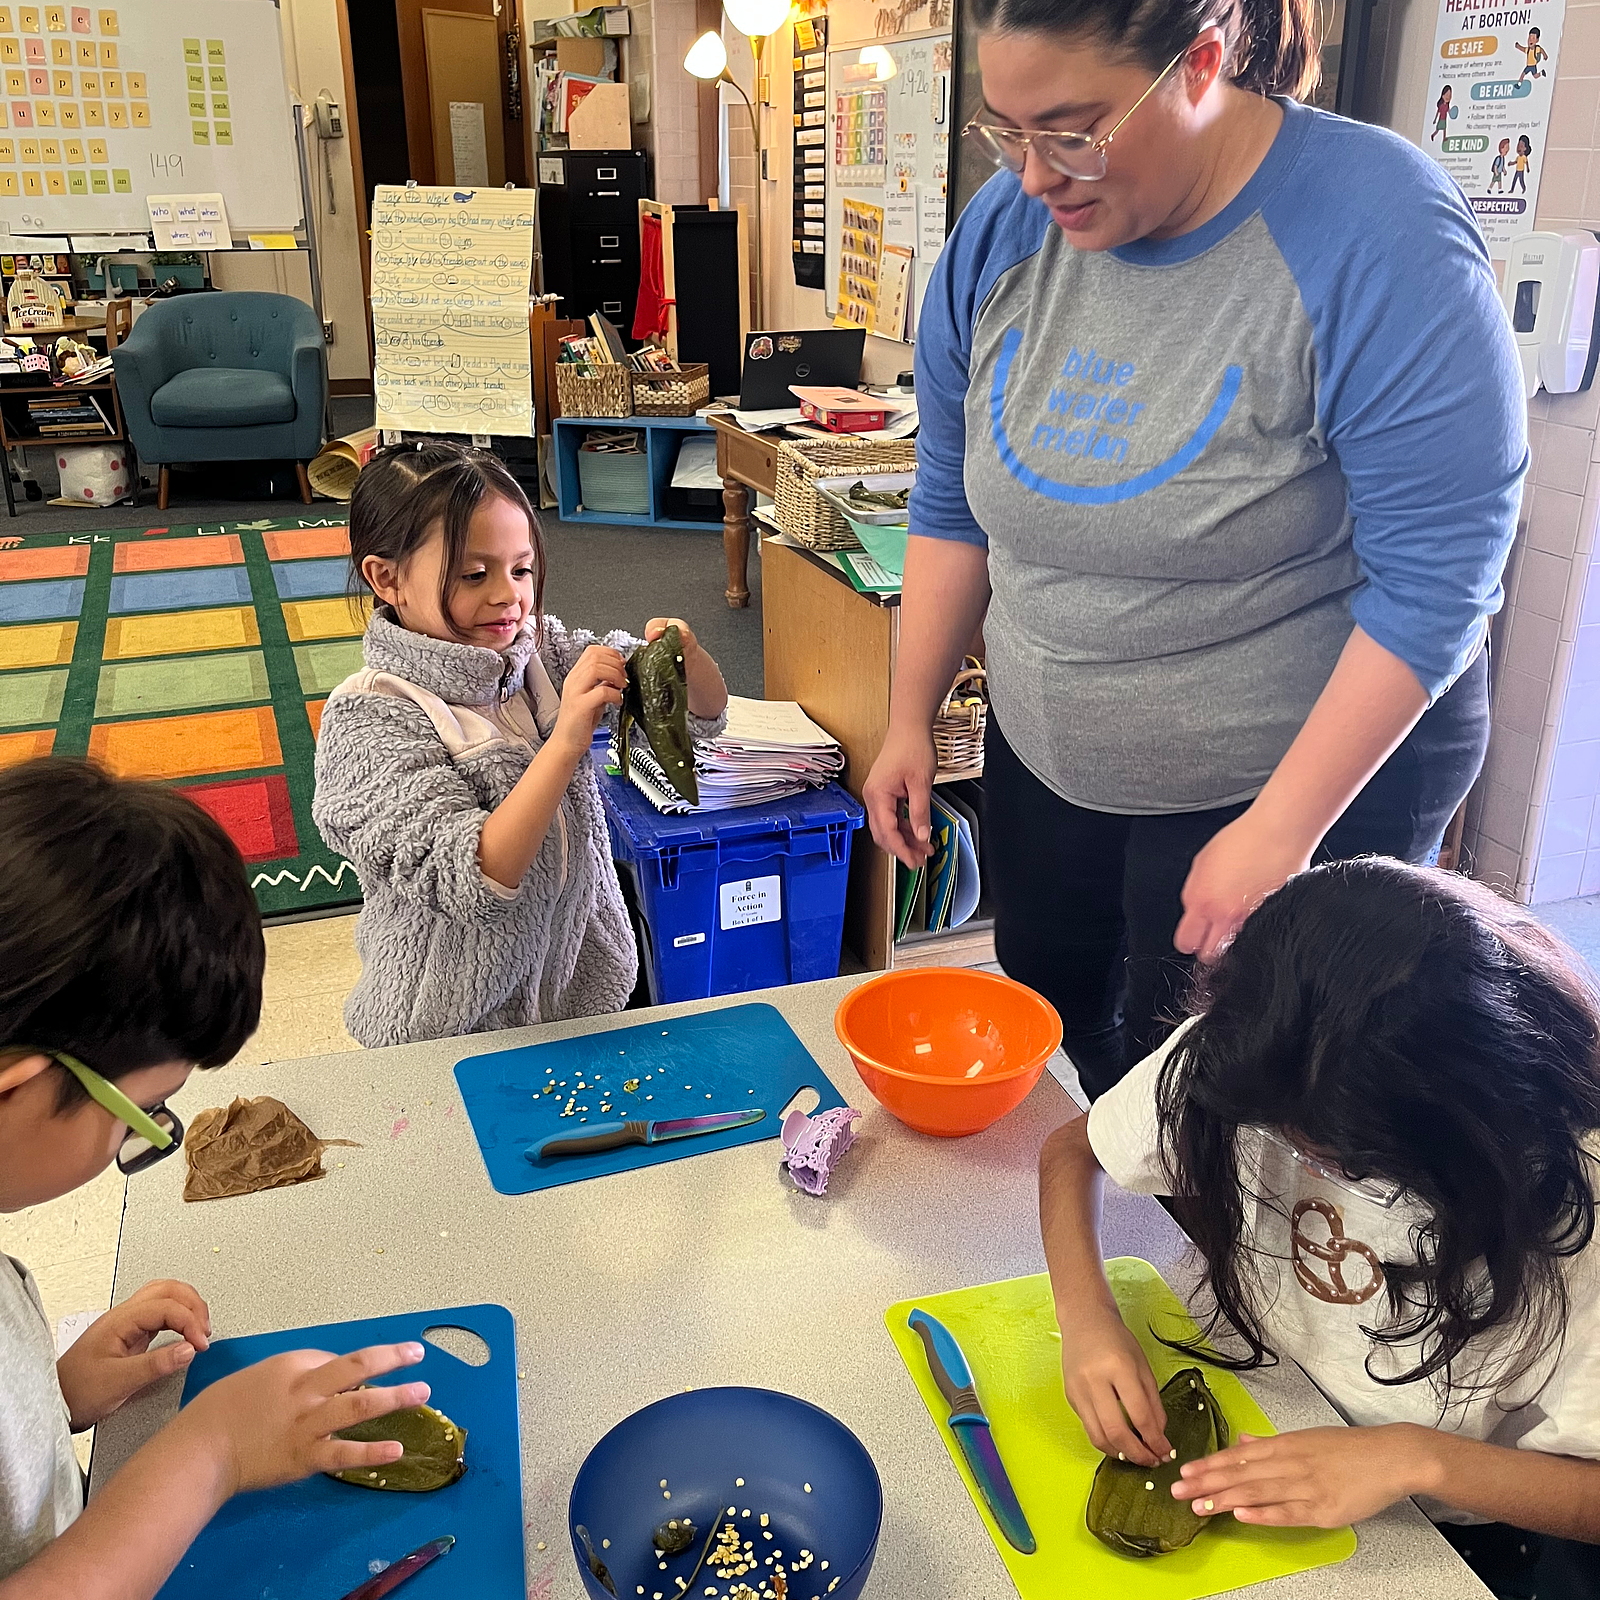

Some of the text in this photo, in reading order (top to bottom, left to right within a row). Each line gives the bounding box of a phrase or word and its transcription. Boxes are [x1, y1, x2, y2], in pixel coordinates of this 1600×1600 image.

[52, 13, 58, 22] d
[106, 17, 111, 25] f
[1462, 9, 1531, 30] AT BORTON!
[6, 45, 13, 53] h
[59, 48, 63, 57] j
[83, 48, 89, 57] k
[1448, 41, 1484, 55] BE SAFE
[59, 79, 66, 88] p
[85, 81, 95, 89] qu
[1479, 84, 1513, 97] BE FAIR
[114, 112, 120, 121] y
[1449, 139, 1483, 151] BE KIND
[70, 147, 78, 155] th
[6, 178, 11, 187] f
[152, 206, 169, 216] who
[178, 208, 196, 216] what
[1473, 201, 1519, 212] RESPECTFUL
[171, 229, 212, 239] where why
[15, 308, 54, 318] Ice Cream
[1062, 347, 1135, 387] blue
[1049, 387, 1145, 427] water
[1031, 424, 1129, 463] melon
[69, 534, 111, 545] Kk
[732, 894, 755, 903] Force
[735, 903, 763, 913] Action
